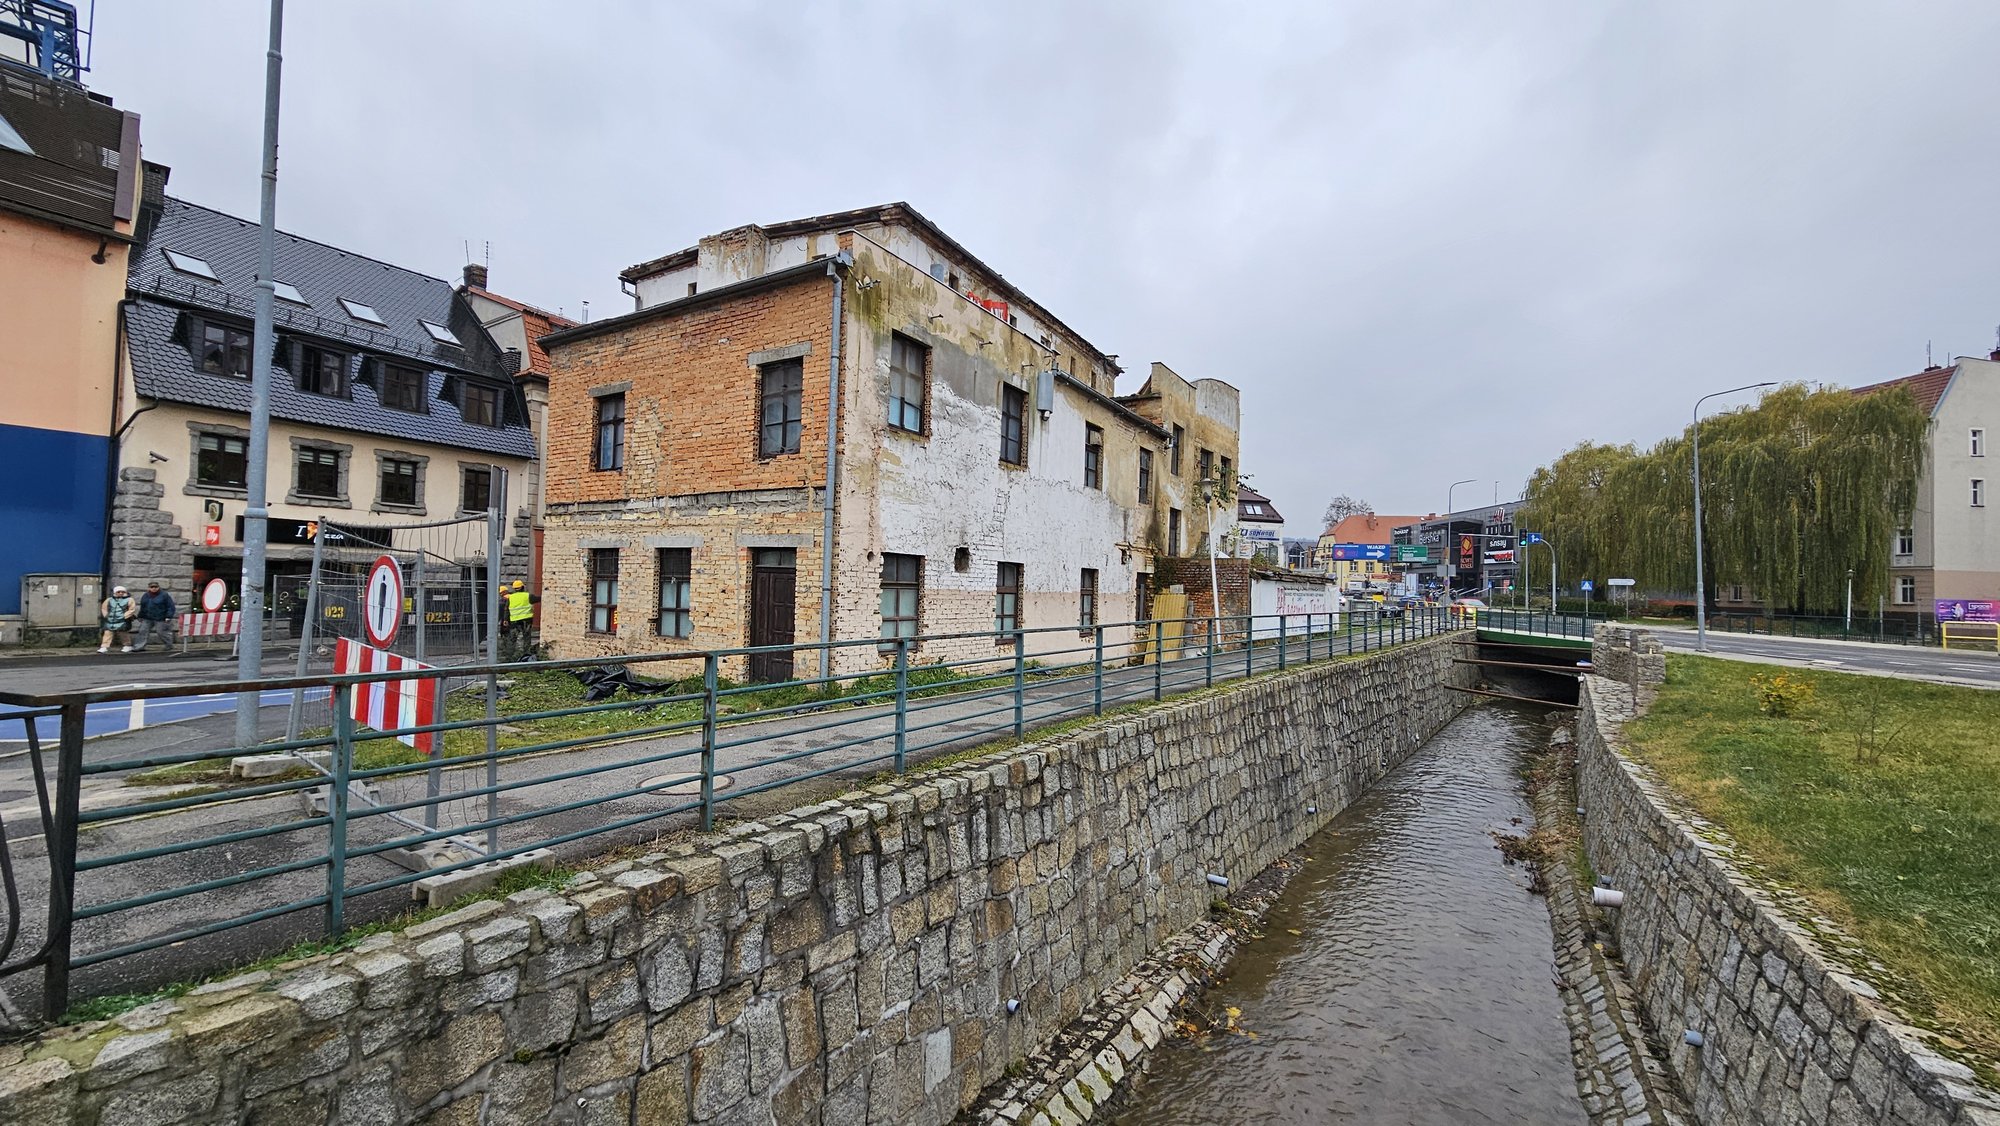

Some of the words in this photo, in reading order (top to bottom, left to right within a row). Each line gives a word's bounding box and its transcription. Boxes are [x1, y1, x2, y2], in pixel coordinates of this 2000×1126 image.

[296, 525, 307, 537] I
[324, 606, 344, 619] 023
[425, 611, 451, 623] 023
